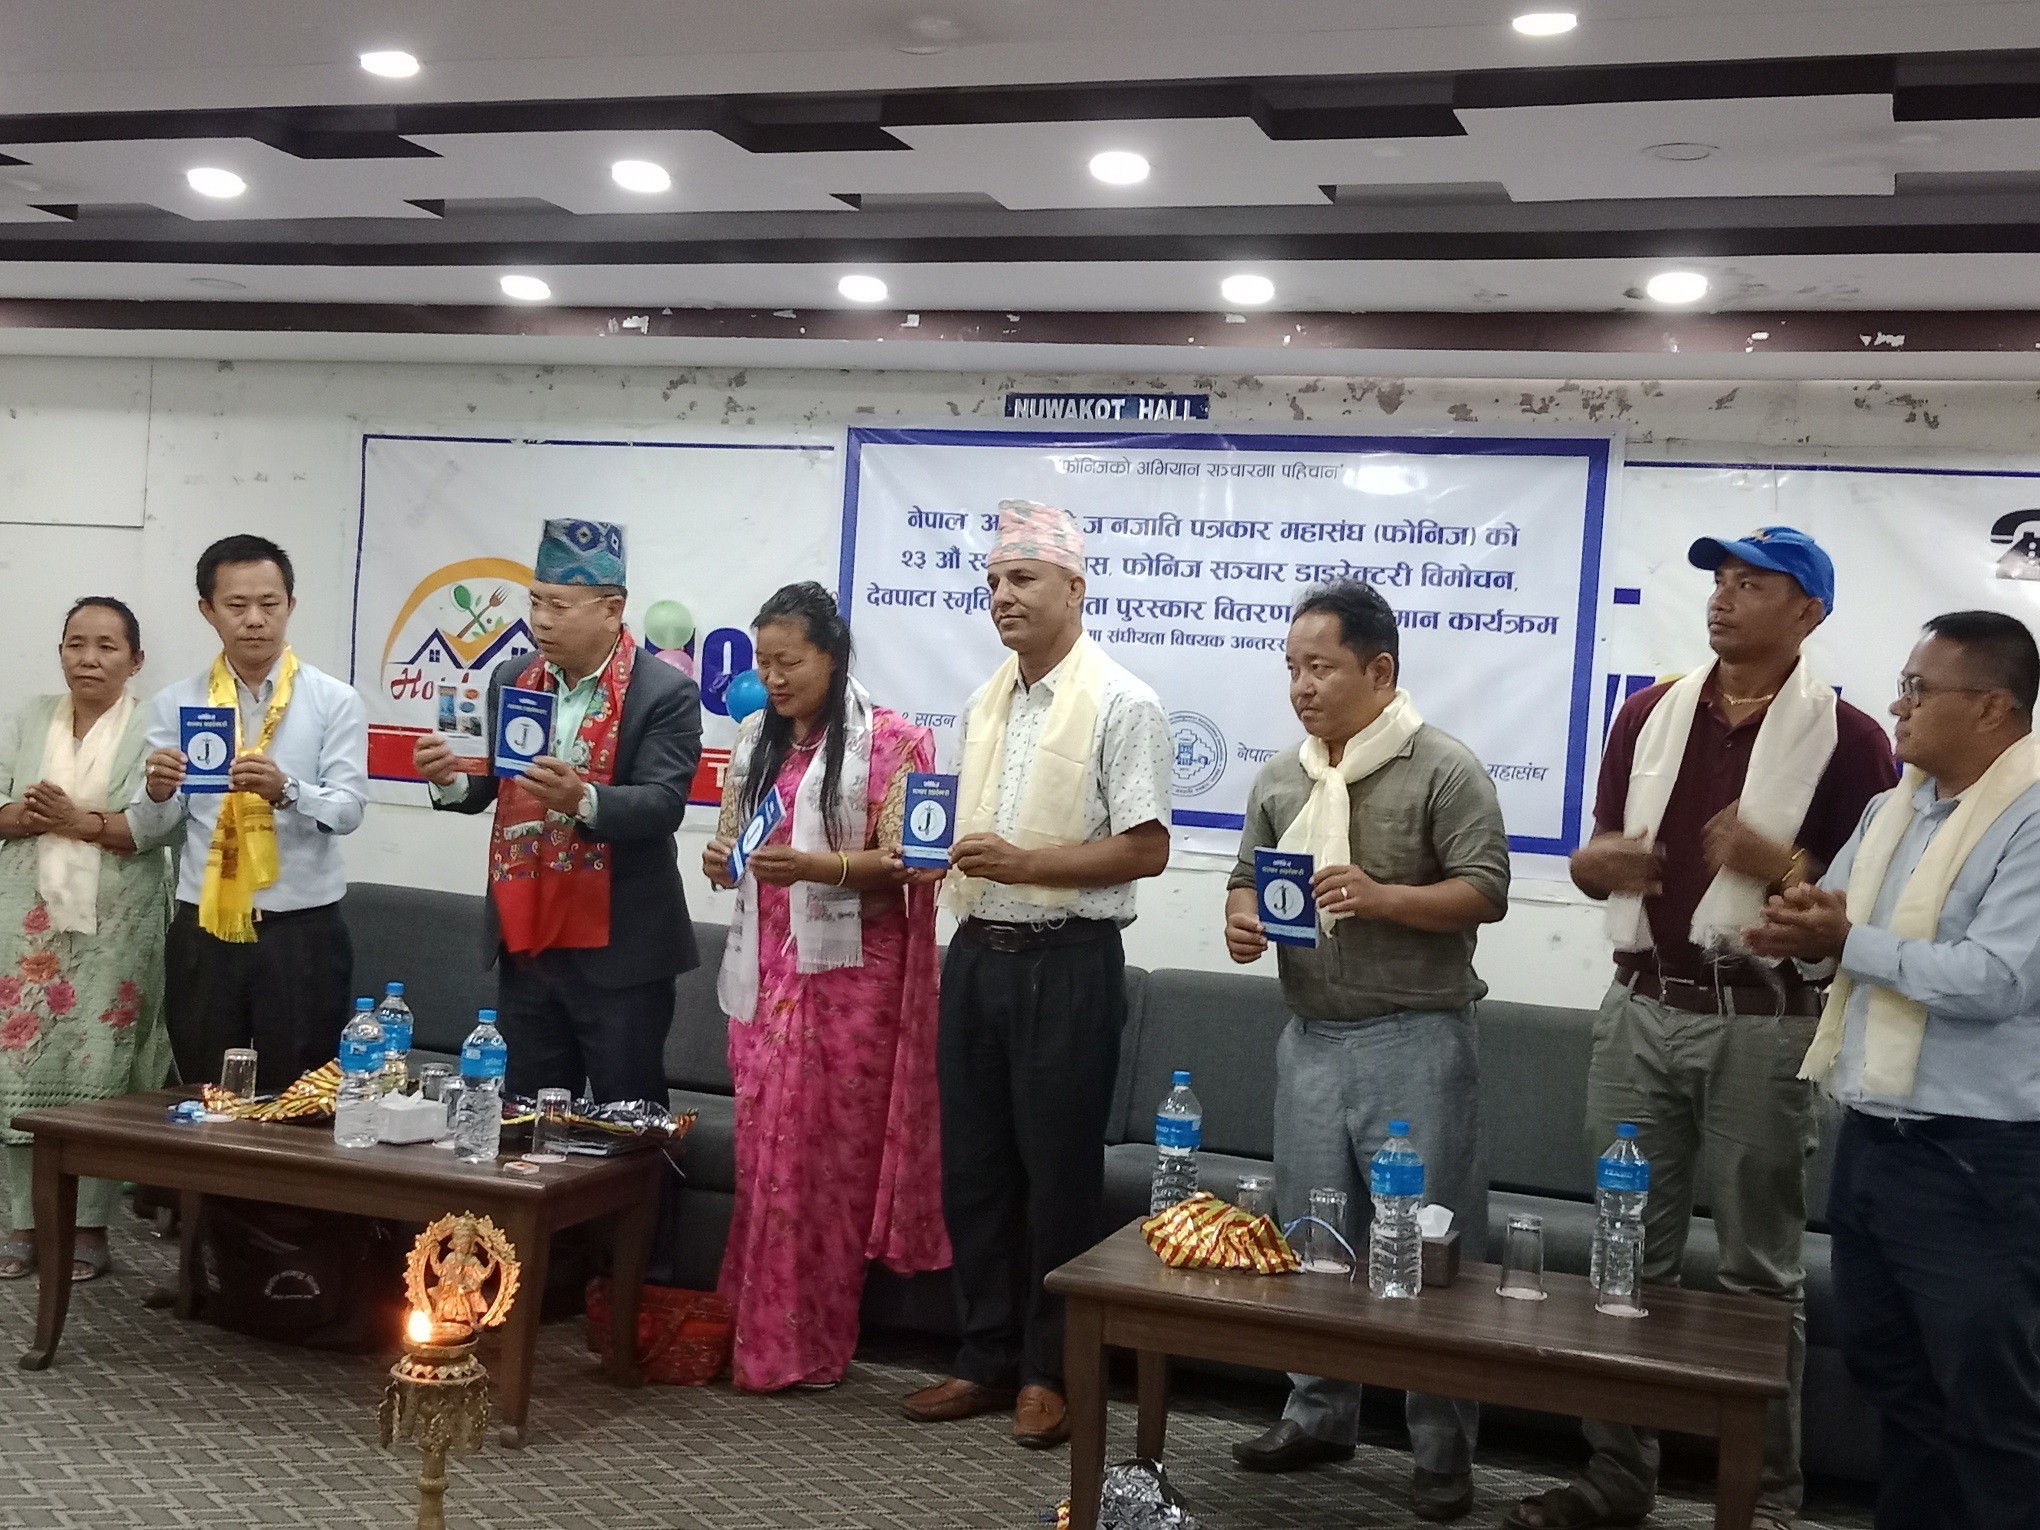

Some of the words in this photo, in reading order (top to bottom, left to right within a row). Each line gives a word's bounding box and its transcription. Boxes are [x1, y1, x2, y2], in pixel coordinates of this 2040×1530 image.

[1014, 397, 1126, 420] NUWAKOT
[1138, 398, 1197, 421] HALL
[1136, 458, 1200, 476] अभियान
[907, 505, 969, 530] नेपाल
[1190, 518, 1273, 541] पत्रकार
[1280, 519, 1366, 543] महासंघ
[1373, 518, 1477, 546] (फोनिज)
[1485, 521, 1521, 547] को
[901, 549, 927, 570] २३
[1122, 552, 1204, 579] फोनिज
[1210, 559, 1290, 583] सञ्चार
[866, 583, 937, 608] देवपाटा
[942, 587, 991, 615] स्मृति
[1116, 596, 1208, 622] पुरस्कार
[1214, 595, 1293, 624] वितरण
[1448, 608, 1560, 636] कार्यक्रम
[1106, 627, 1166, 646] संघीयता
[1170, 629, 1226, 648] विषयक
[914, 712, 958, 728] साउन
[1486, 761, 1550, 781] महासंघ
